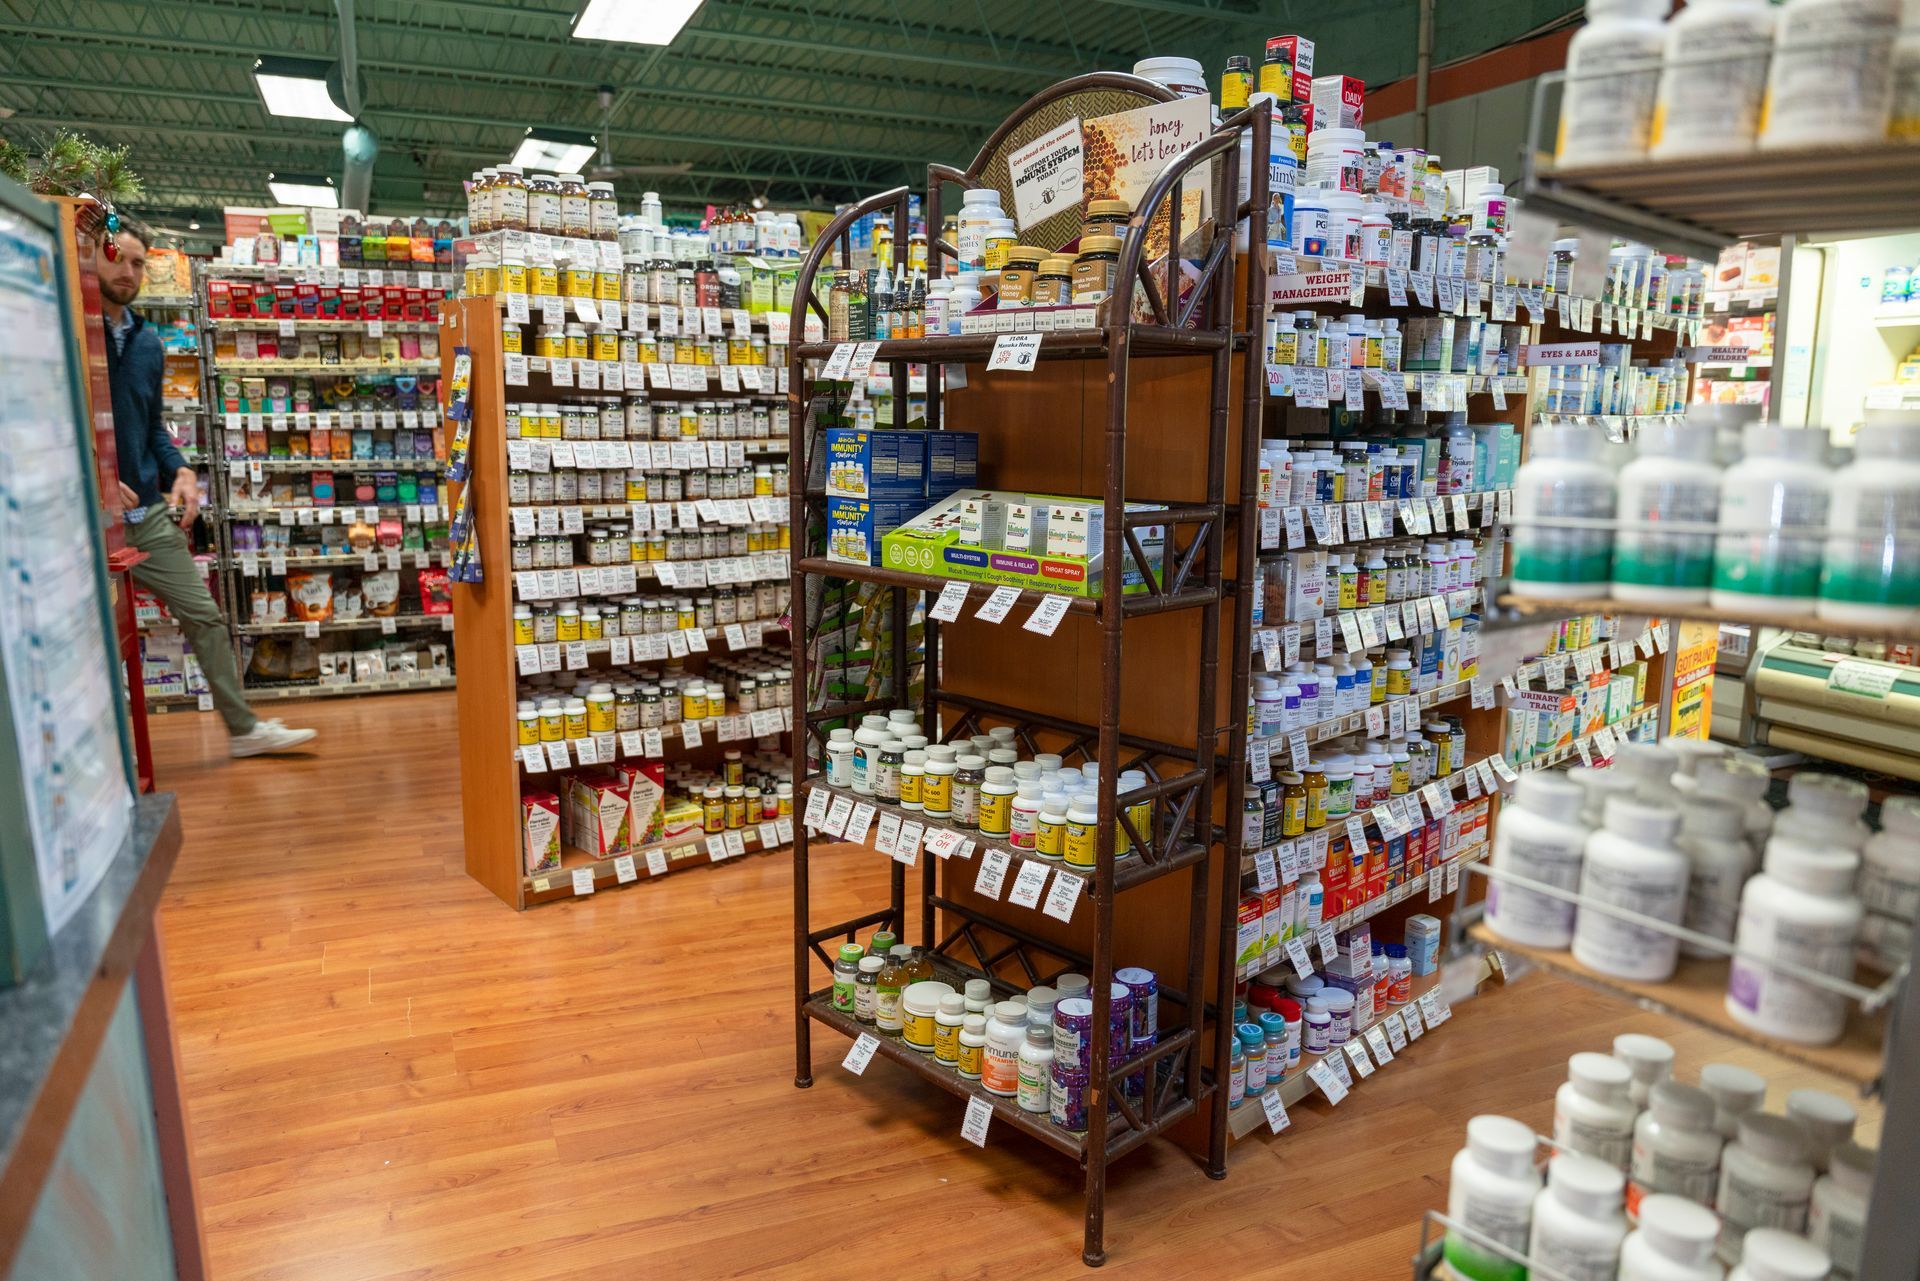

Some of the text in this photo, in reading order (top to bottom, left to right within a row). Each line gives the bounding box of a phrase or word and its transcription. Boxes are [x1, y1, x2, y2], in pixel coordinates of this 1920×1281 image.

[1345, 92, 1361, 106] DAILY
[1150, 118, 1183, 137] honey,
[1023, 148, 1039, 161] ahead
[1046, 139, 1055, 148] the
[1056, 128, 1075, 143] season
[1023, 145, 1068, 174] SUPPORT YOUR
[1015, 145, 1080, 188] IMMUNE SYSTEM
[1306, 273, 1350, 285] WEIGHT
[1001, 290, 1020, 299] Honey
[1272, 286, 1350, 300] MANAGEMENT
[771, 320, 788, 330] Sale
[1574, 349, 1598, 358] EARS
[995, 357, 1008, 365] OFF
[831, 443, 864, 453] IMMUNITY
[832, 510, 866, 521] IMMUNITY
[951, 553, 981, 562] MULTI-SYSTEM
[996, 559, 1014, 567] IMMUNE
[1045, 566, 1064, 574] THROAT
[987, 573, 1002, 582] Cough
[1029, 579, 1057, 589] Respiratory
[136, 608, 160, 617] EARTH
[1676, 646, 1716, 673] GOT PAIN?
[1520, 692, 1559, 703] URINARY
[1529, 702, 1559, 711] TRACT
[1014, 811, 1024, 819] Zinc
[935, 839, 950, 850] Off
[1328, 864, 1347, 877] CRAMPS
[1370, 862, 1385, 874] CRAMPS
[1350, 873, 1364, 885] CRAMPS
[990, 1055, 1013, 1064] VITAMIN
